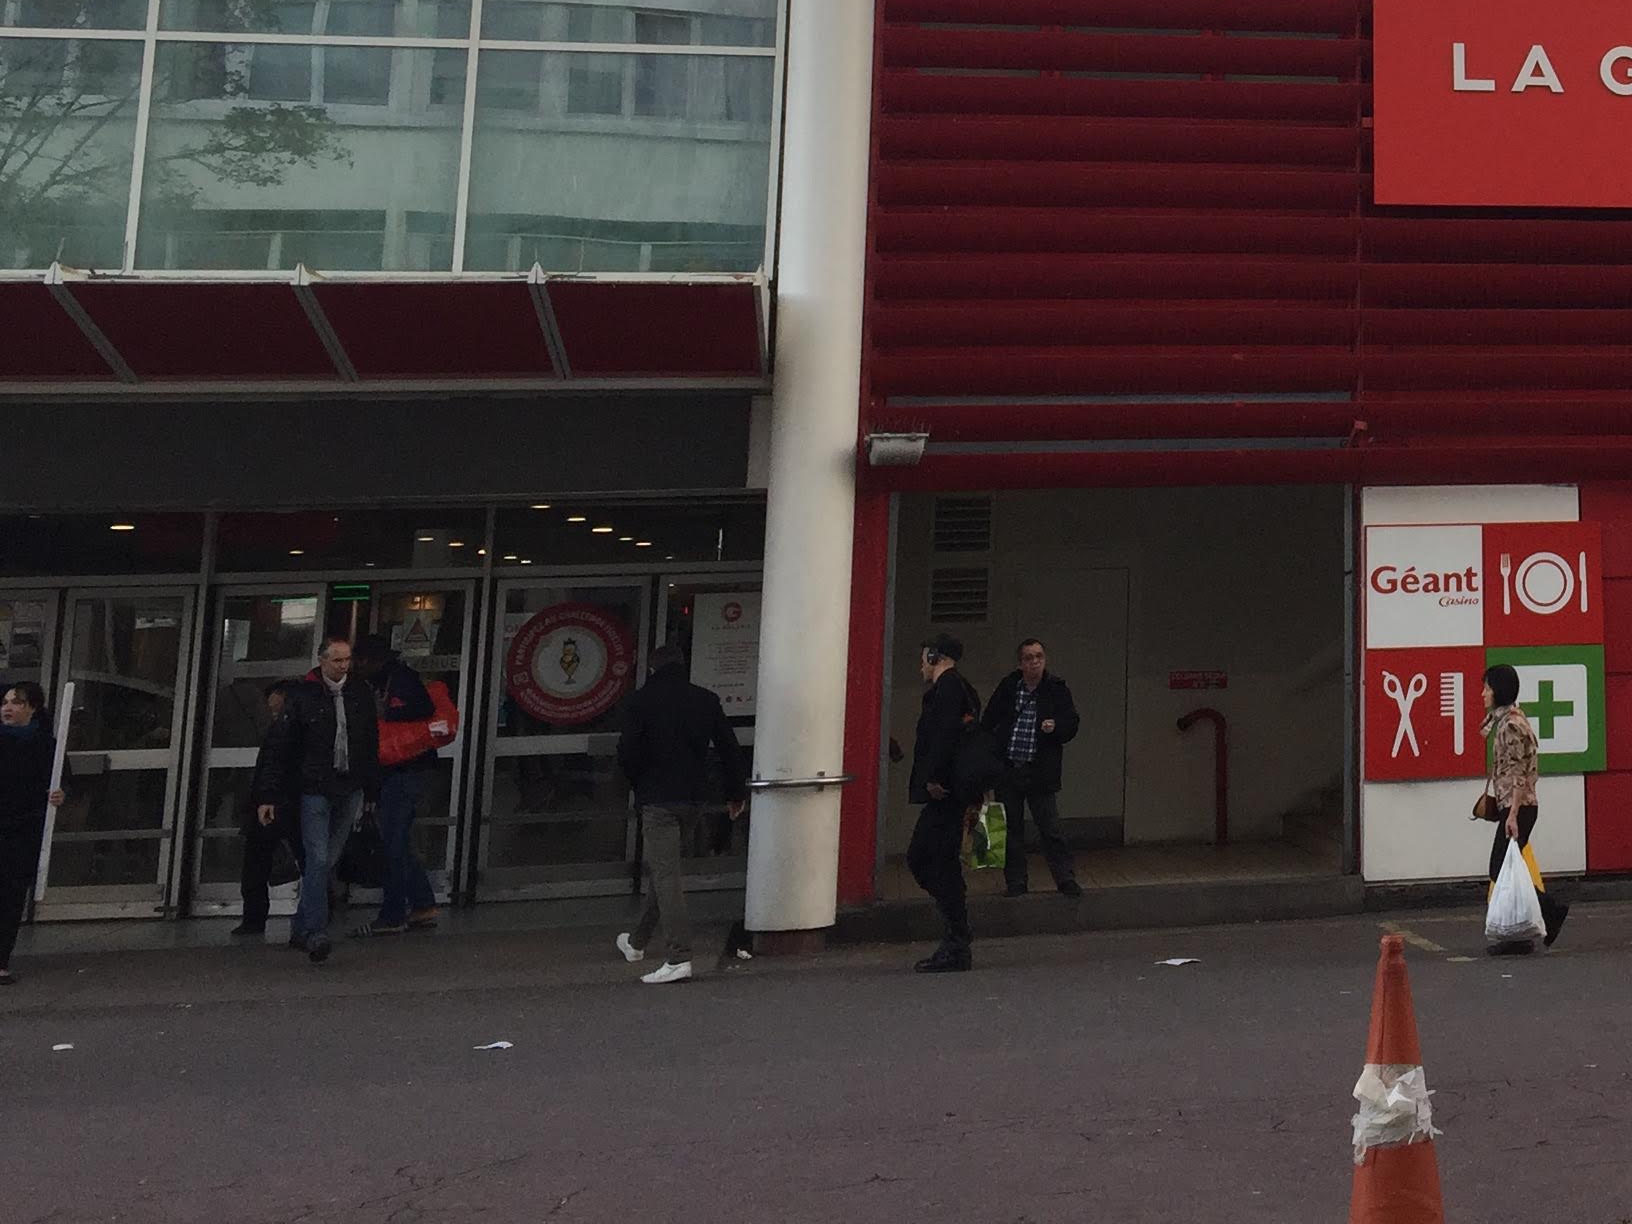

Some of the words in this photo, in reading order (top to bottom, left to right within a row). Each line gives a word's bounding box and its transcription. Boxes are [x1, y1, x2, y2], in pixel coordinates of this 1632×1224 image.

[1452, 42, 1564, 93] LA
[1370, 565, 1480, 595] Géant
[1438, 595, 1480, 608] Casino
